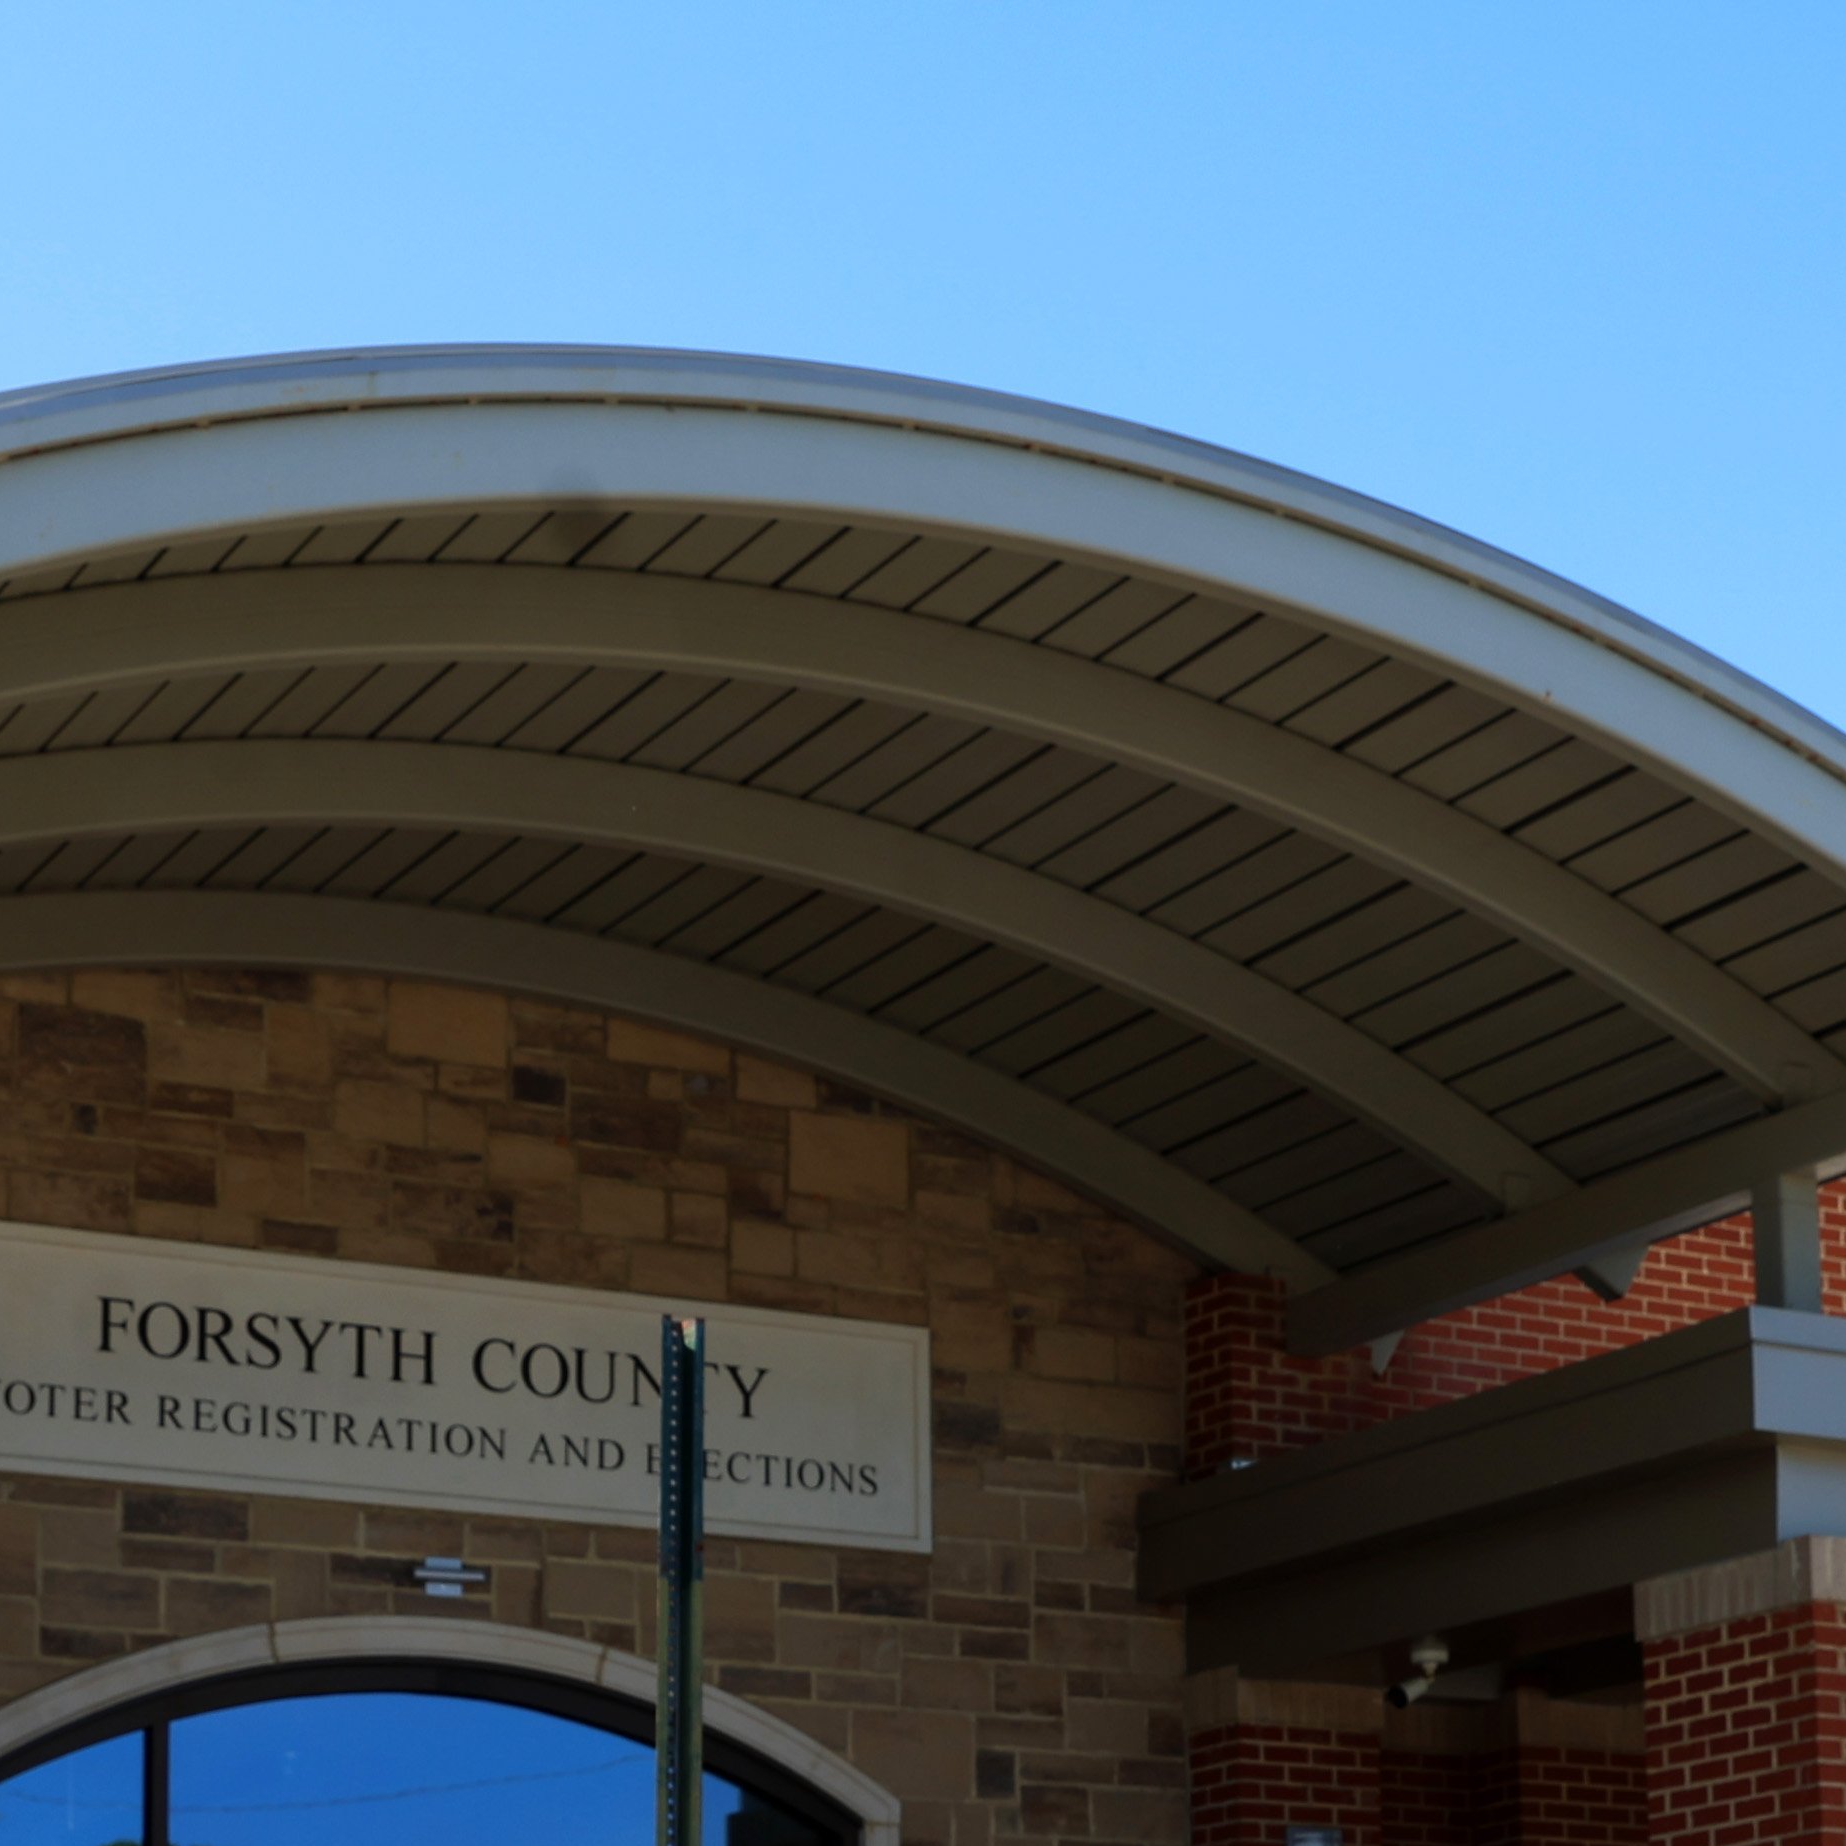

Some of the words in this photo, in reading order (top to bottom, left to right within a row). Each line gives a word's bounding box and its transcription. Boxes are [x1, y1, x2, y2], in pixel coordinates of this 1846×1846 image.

[96, 1296, 436, 1386] FORSYTH
[472, 1337, 770, 1418] COUNY
[157, 1395, 507, 1460] REGISTRATION
[528, 1433, 625, 1471] AND
[645, 1443, 879, 1497] EECTIONS
